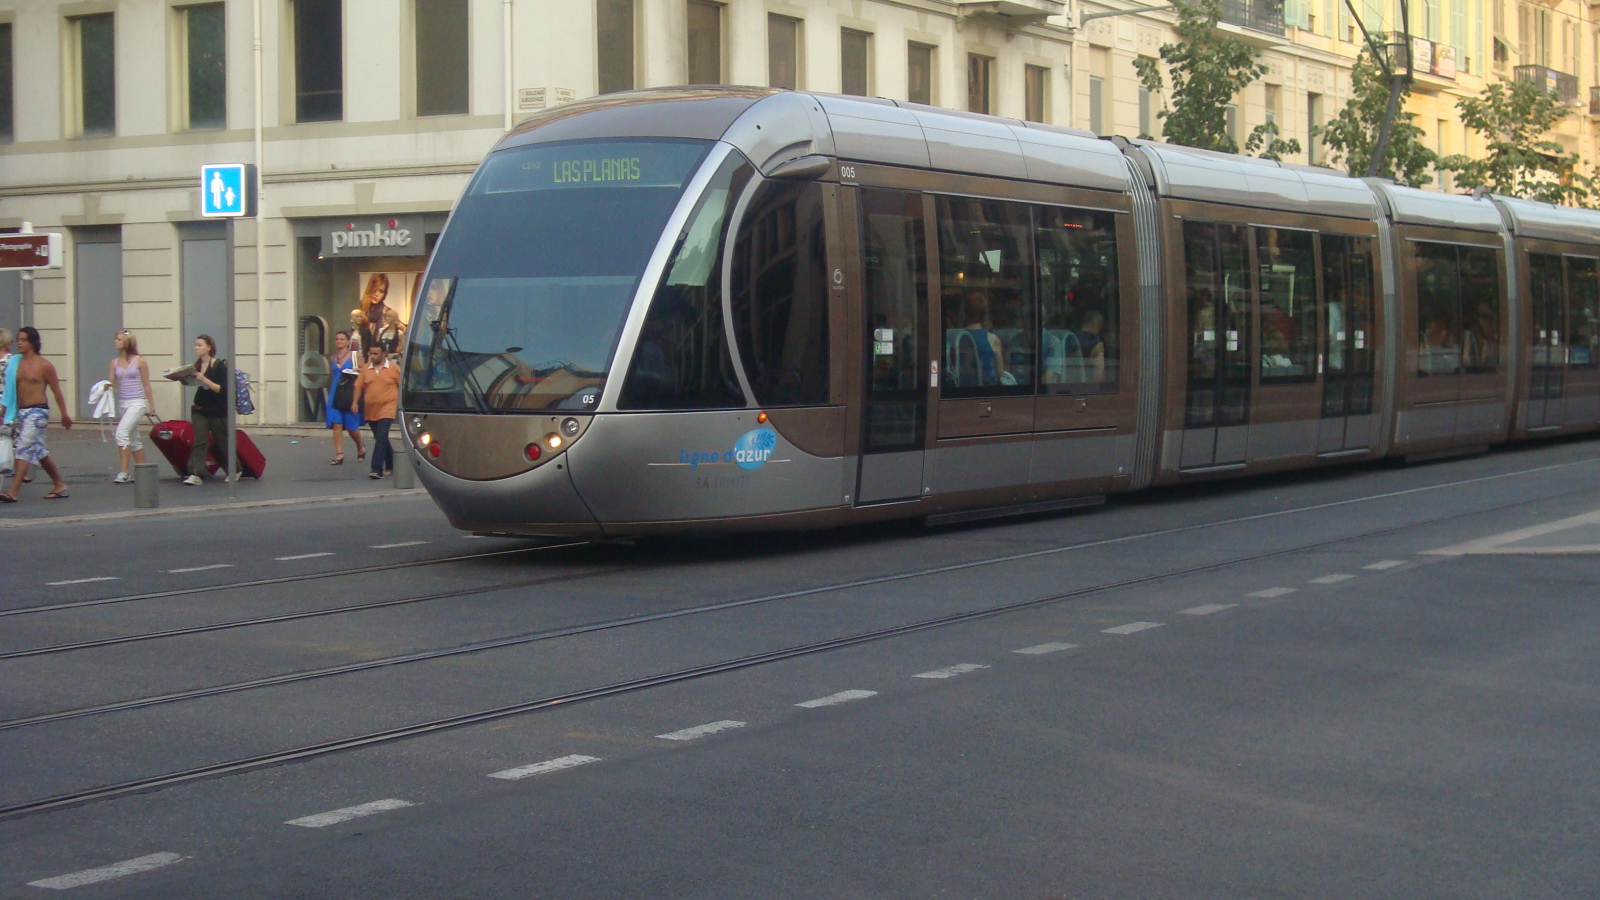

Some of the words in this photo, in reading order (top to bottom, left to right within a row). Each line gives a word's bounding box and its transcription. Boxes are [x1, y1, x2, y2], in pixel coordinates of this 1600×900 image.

[553, 160, 581, 183] LAS
[583, 157, 640, 182] PLANAS
[841, 166, 856, 178] 005
[331, 219, 411, 254] pimkie
[582, 394, 595, 404] 05
[679, 450, 719, 469] ligne
[723, 447, 771, 463] d'azur
